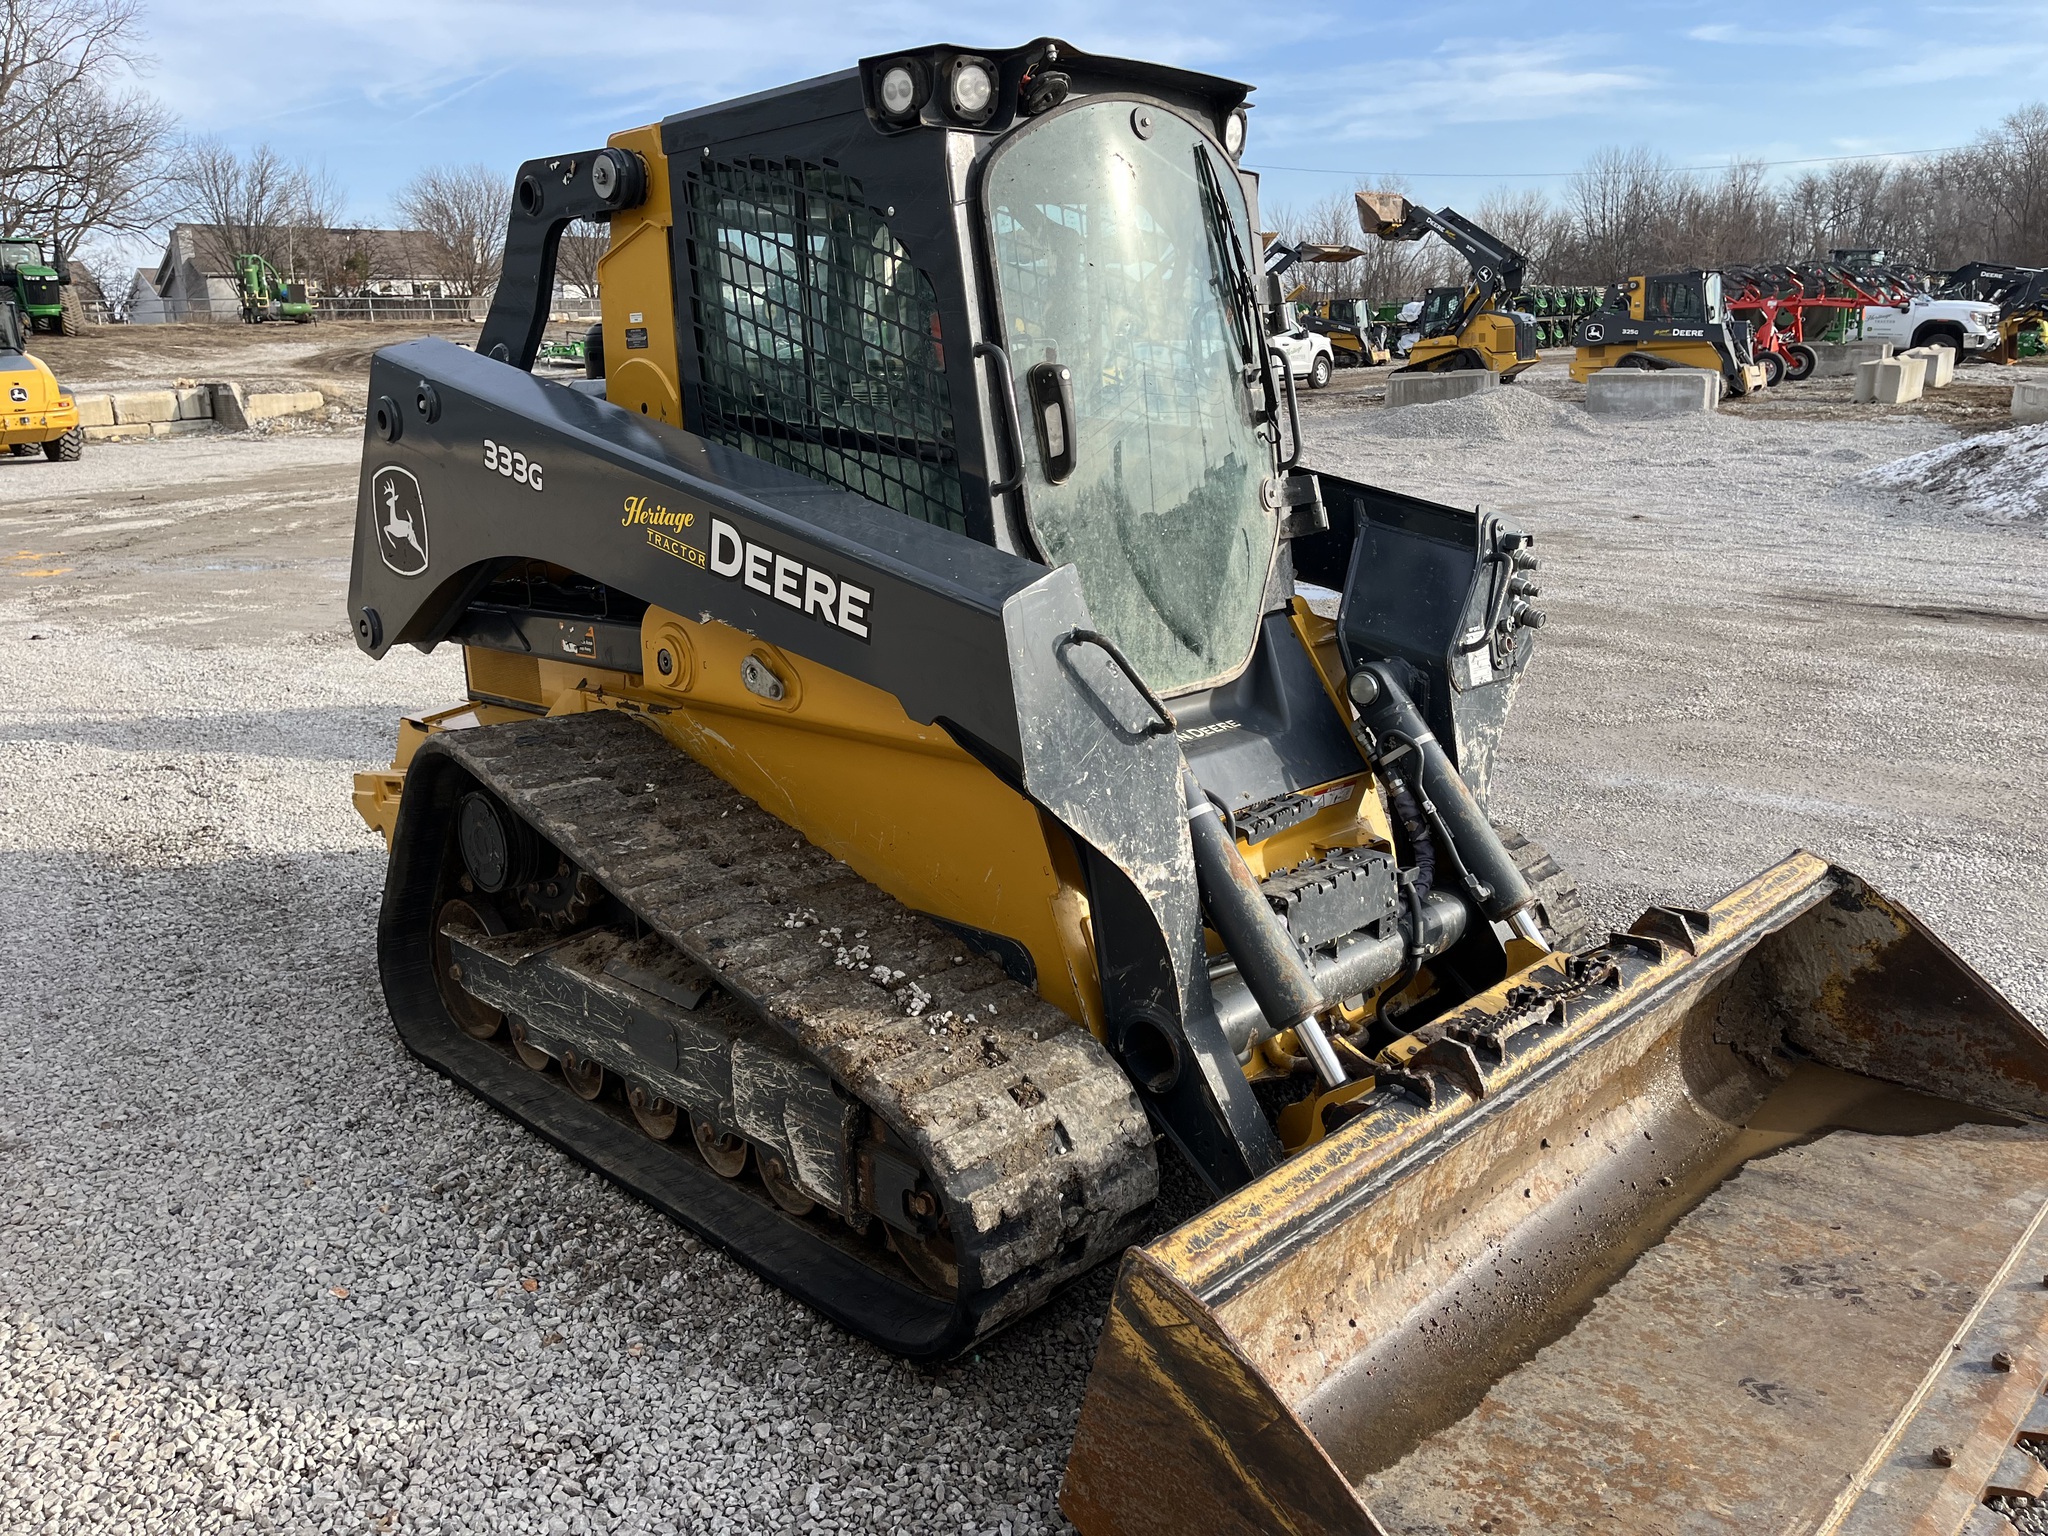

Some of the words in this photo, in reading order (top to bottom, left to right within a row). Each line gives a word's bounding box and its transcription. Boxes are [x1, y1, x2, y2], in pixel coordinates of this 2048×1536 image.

[1980, 271, 2004, 279] DEERE
[1672, 328, 1704, 337] DEERE
[483, 439, 543, 491] 333G
[621, 496, 695, 534] Heritage
[647, 530, 706, 567] TRACTOR
[710, 518, 871, 639] DEERE
[1186, 719, 1242, 738] DEERE
